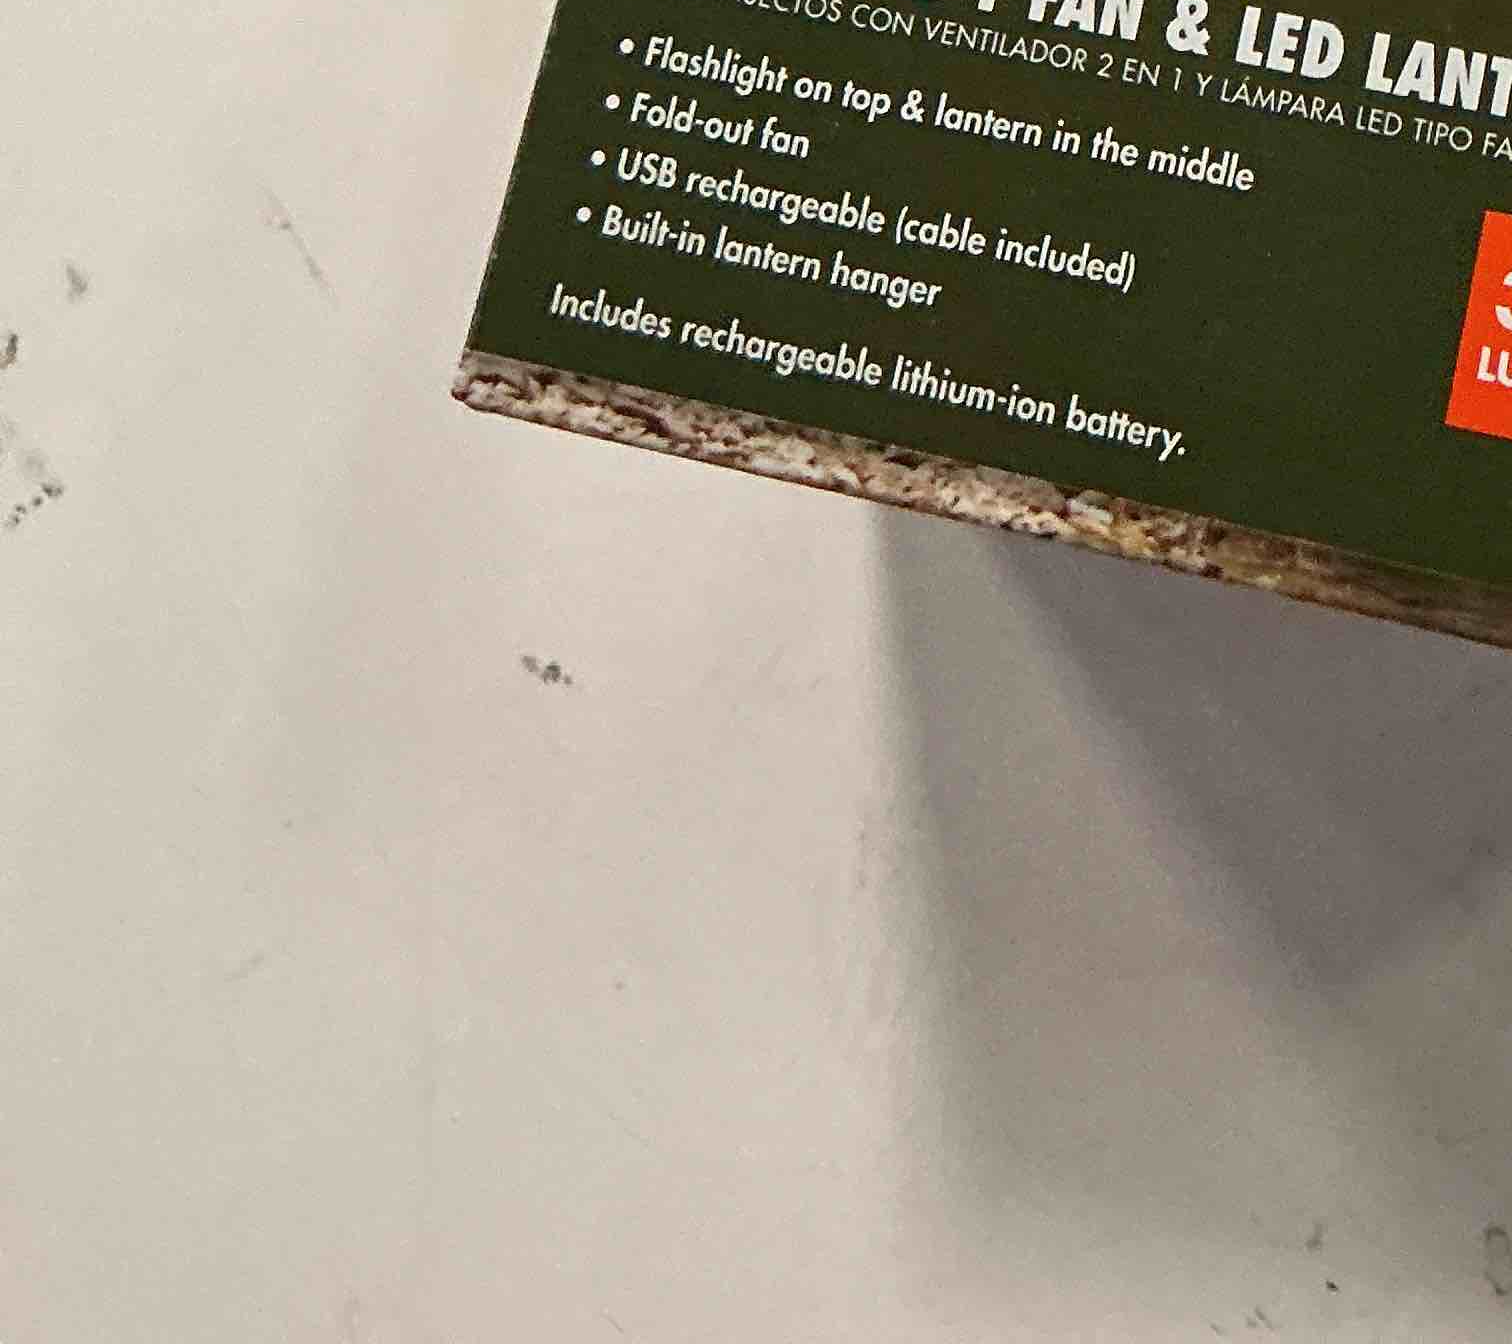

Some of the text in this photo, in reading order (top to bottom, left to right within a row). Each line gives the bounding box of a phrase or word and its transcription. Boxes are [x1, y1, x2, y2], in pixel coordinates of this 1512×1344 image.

[644, 36, 1256, 192] Flashlight on top & lantern in the middle
[851, 3, 916, 37] CON
[924, 17, 1088, 73] VENTILADOR
[1096, 53, 1115, 79] 2
[1122, 57, 1161, 88] EN
[1173, 67, 1183, 92] 1
[1197, 72, 1214, 97] Y
[1220, 74, 1346, 127] LÁMPARA
[1355, 105, 1403, 138] LED
[1413, 117, 1474, 152] TIPO
[1234, 5, 1345, 80] LED
[630, 91, 811, 160] Fold-out fan
[601, 204, 944, 310] Built-in lantern hanger
[617, 146, 1136, 295] USB rechargeable (cable included)
[549, 282, 1187, 463] Includes rechargeable lithium-ion battery.
